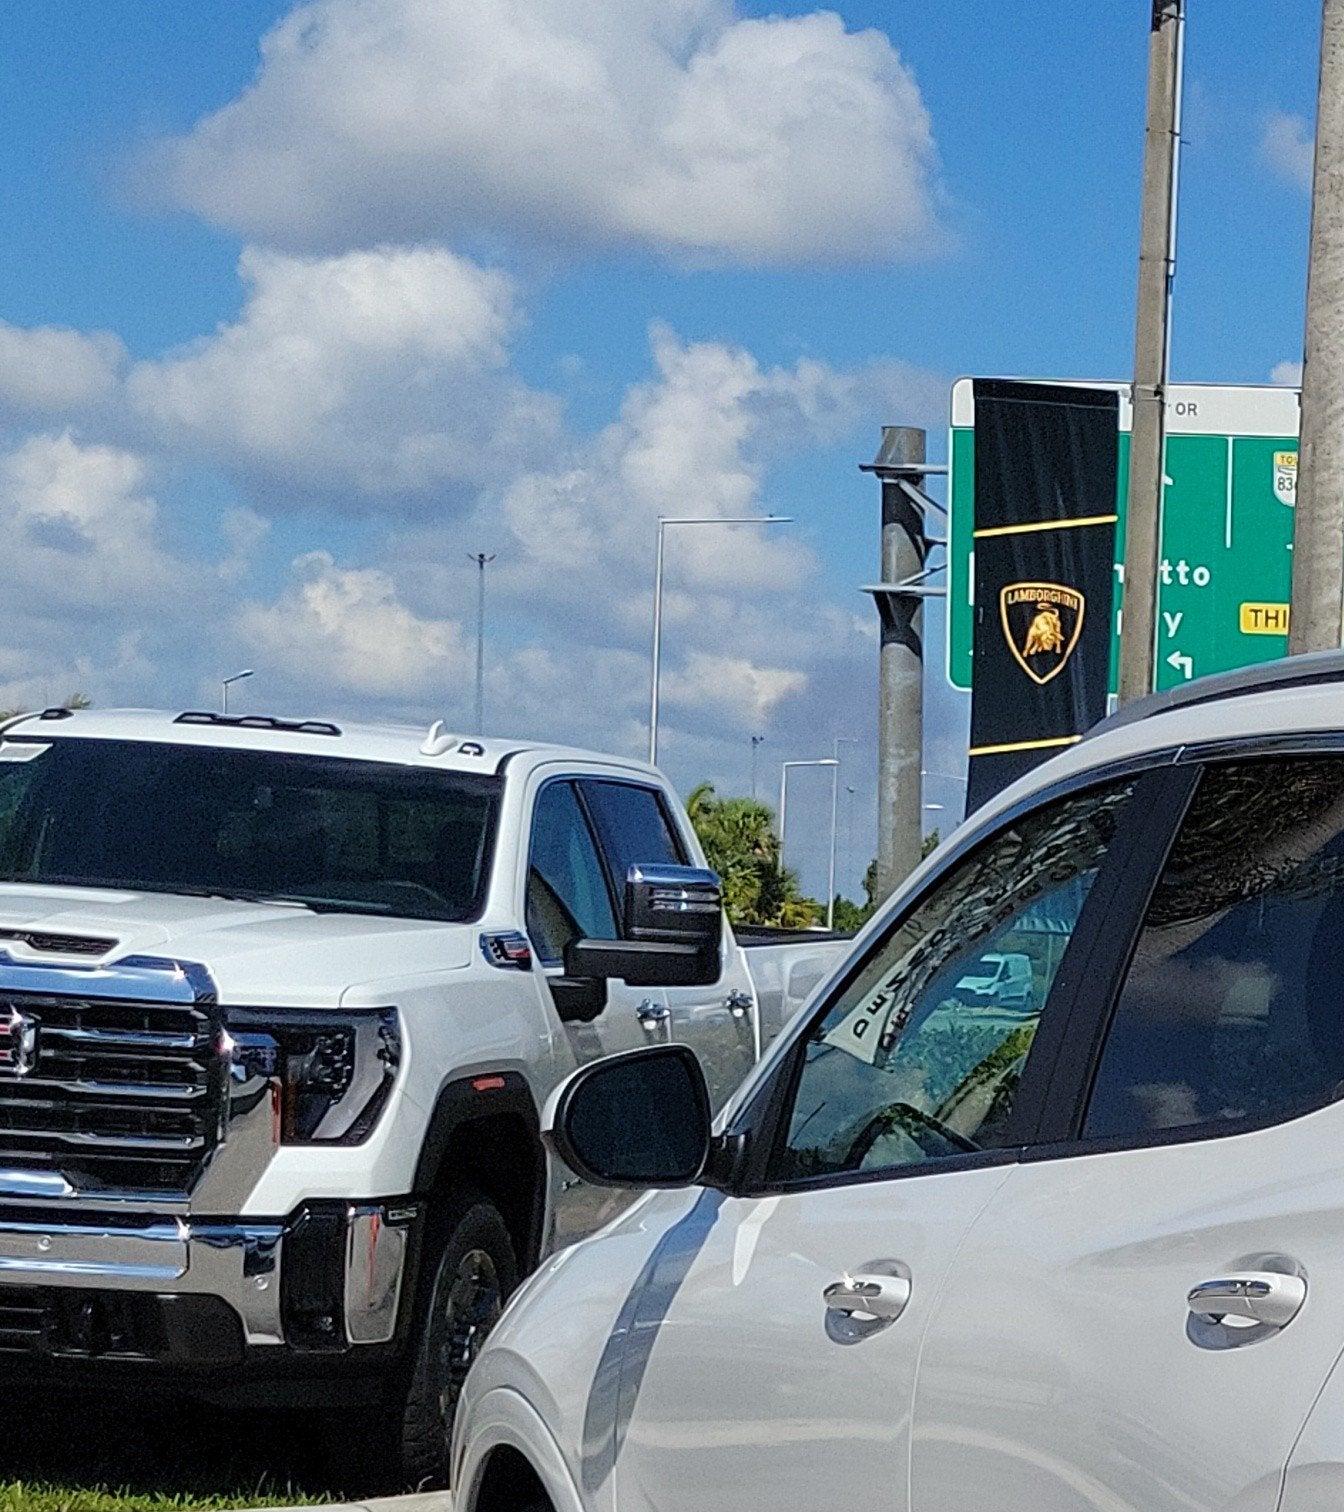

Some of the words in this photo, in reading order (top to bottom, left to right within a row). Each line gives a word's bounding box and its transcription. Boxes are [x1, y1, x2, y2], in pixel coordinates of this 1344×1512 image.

[1175, 402, 1198, 416] OR
[1277, 477, 1297, 492] 83
[1249, 608, 1289, 628] THI
